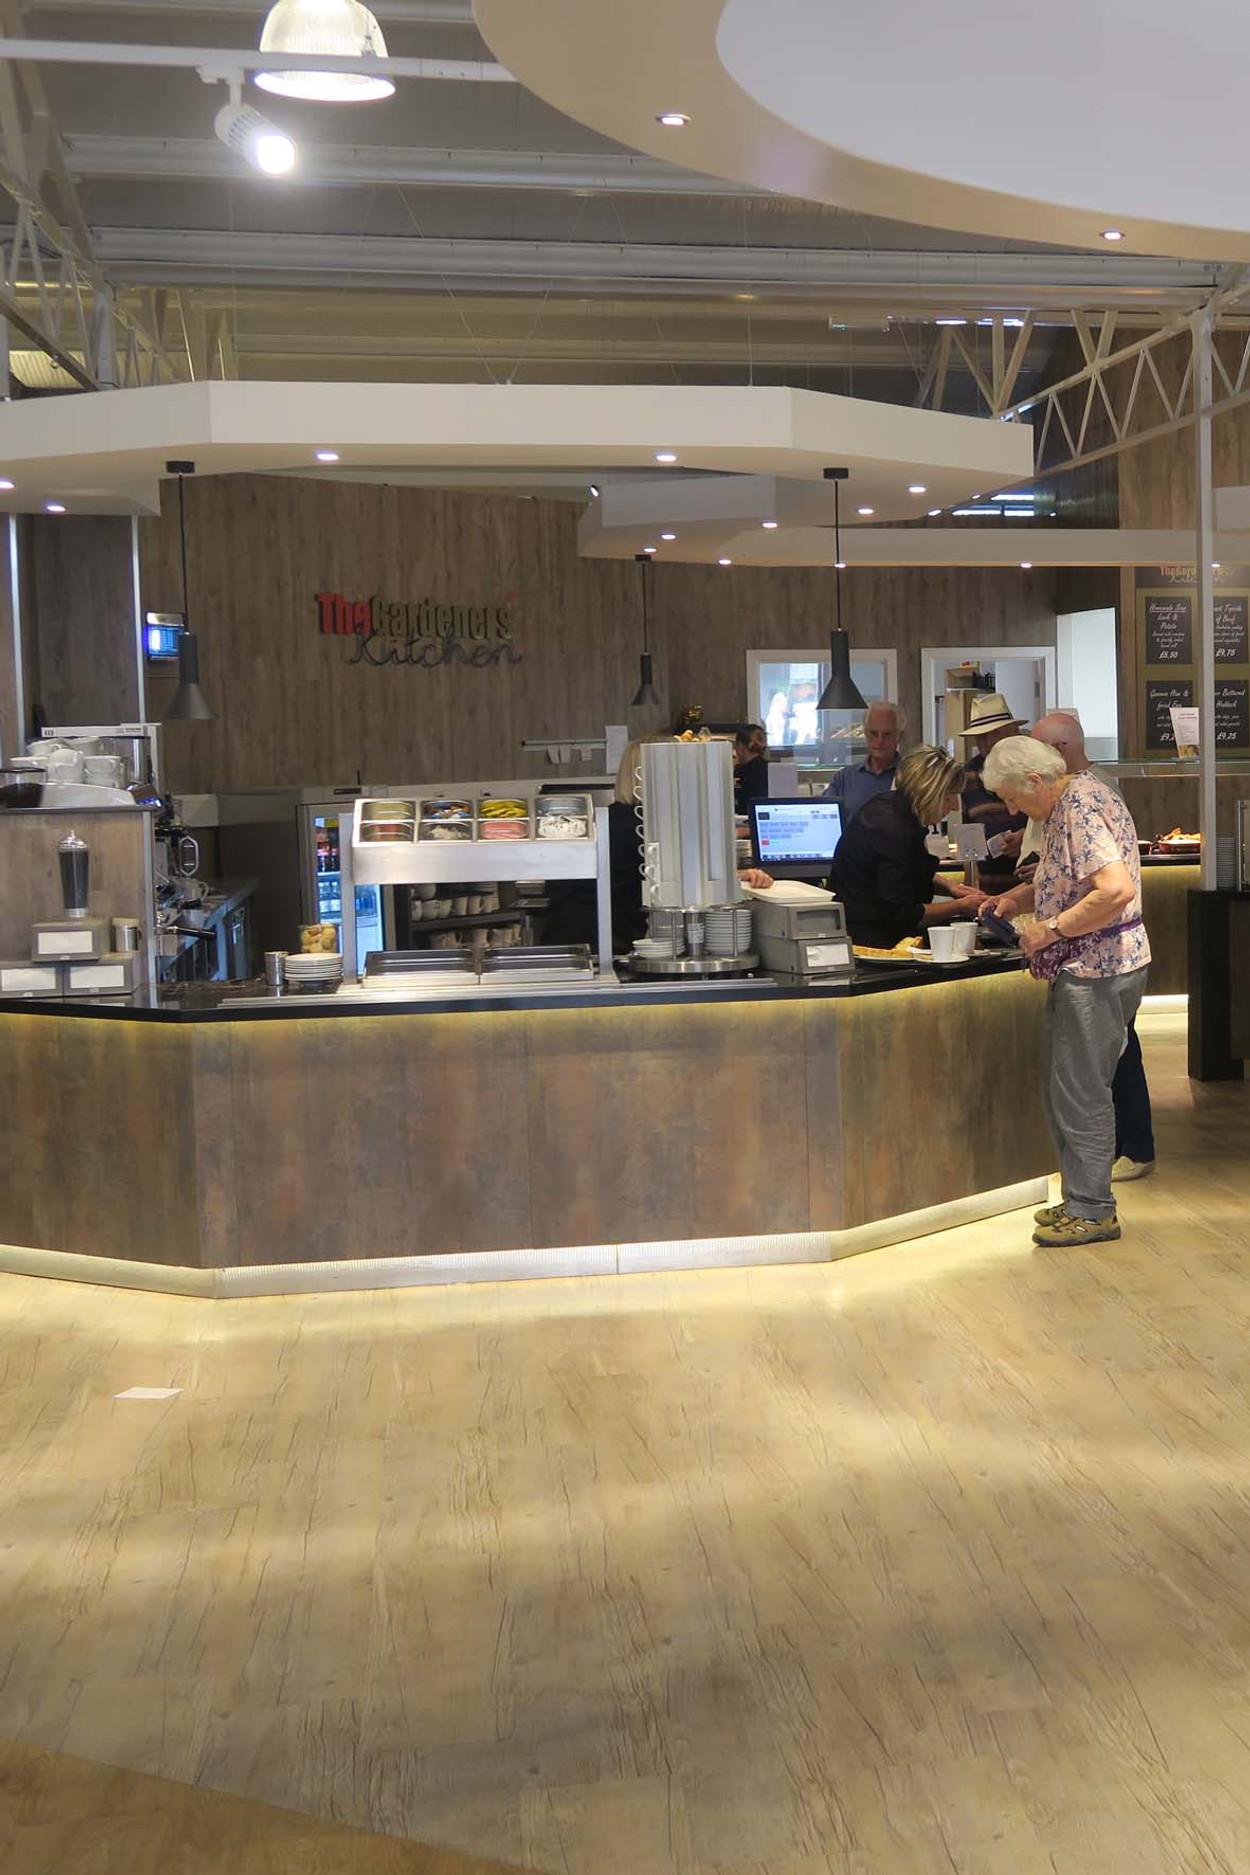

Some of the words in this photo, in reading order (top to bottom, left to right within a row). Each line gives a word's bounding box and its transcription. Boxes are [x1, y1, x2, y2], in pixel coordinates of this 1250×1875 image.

[346, 622, 524, 668] Kitchen
[1215, 648, 1236, 657] £9.75
[1160, 733, 1175, 741] £9.2
